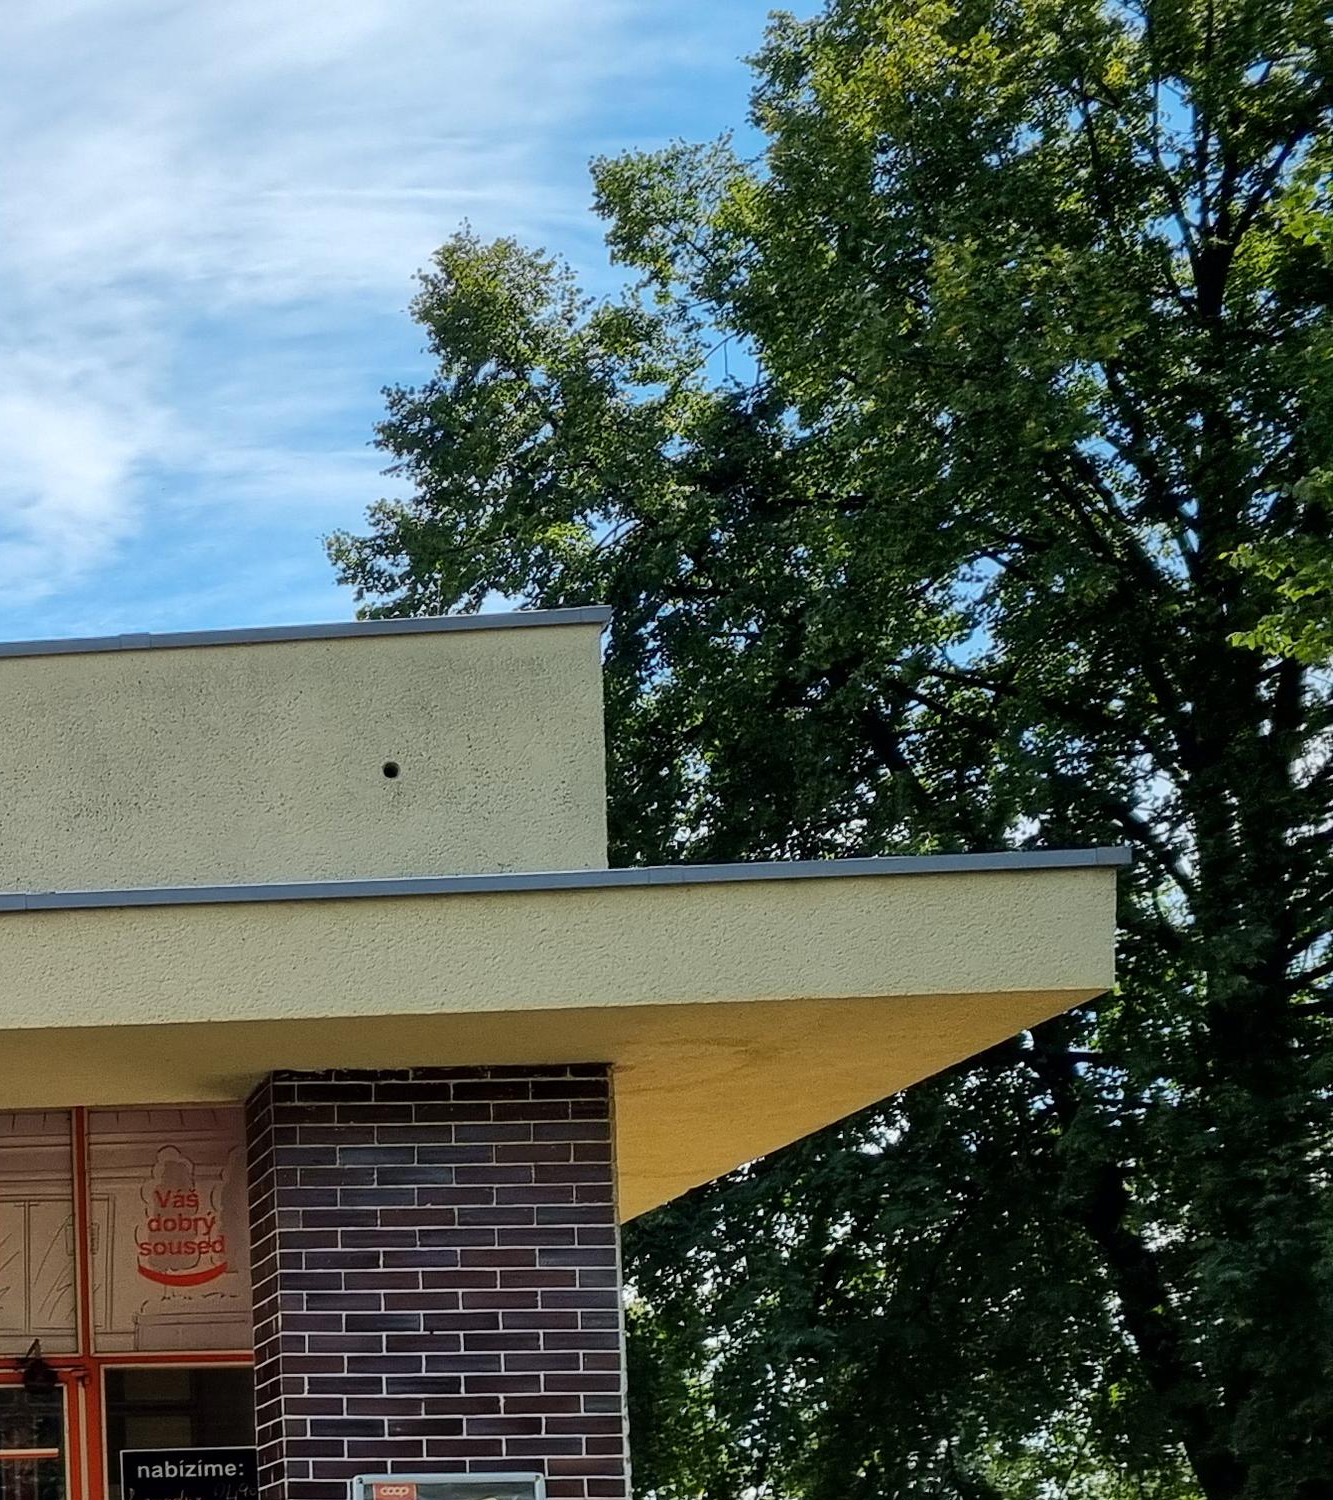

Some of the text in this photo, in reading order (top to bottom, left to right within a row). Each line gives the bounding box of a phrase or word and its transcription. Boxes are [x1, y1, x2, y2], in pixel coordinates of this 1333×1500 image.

[154, 1188, 199, 1209] Váš
[147, 1211, 215, 1236] dobrý
[139, 1235, 225, 1256] soused
[137, 1460, 244, 1478] nabízíme:
[380, 1486, 409, 1497] coop
